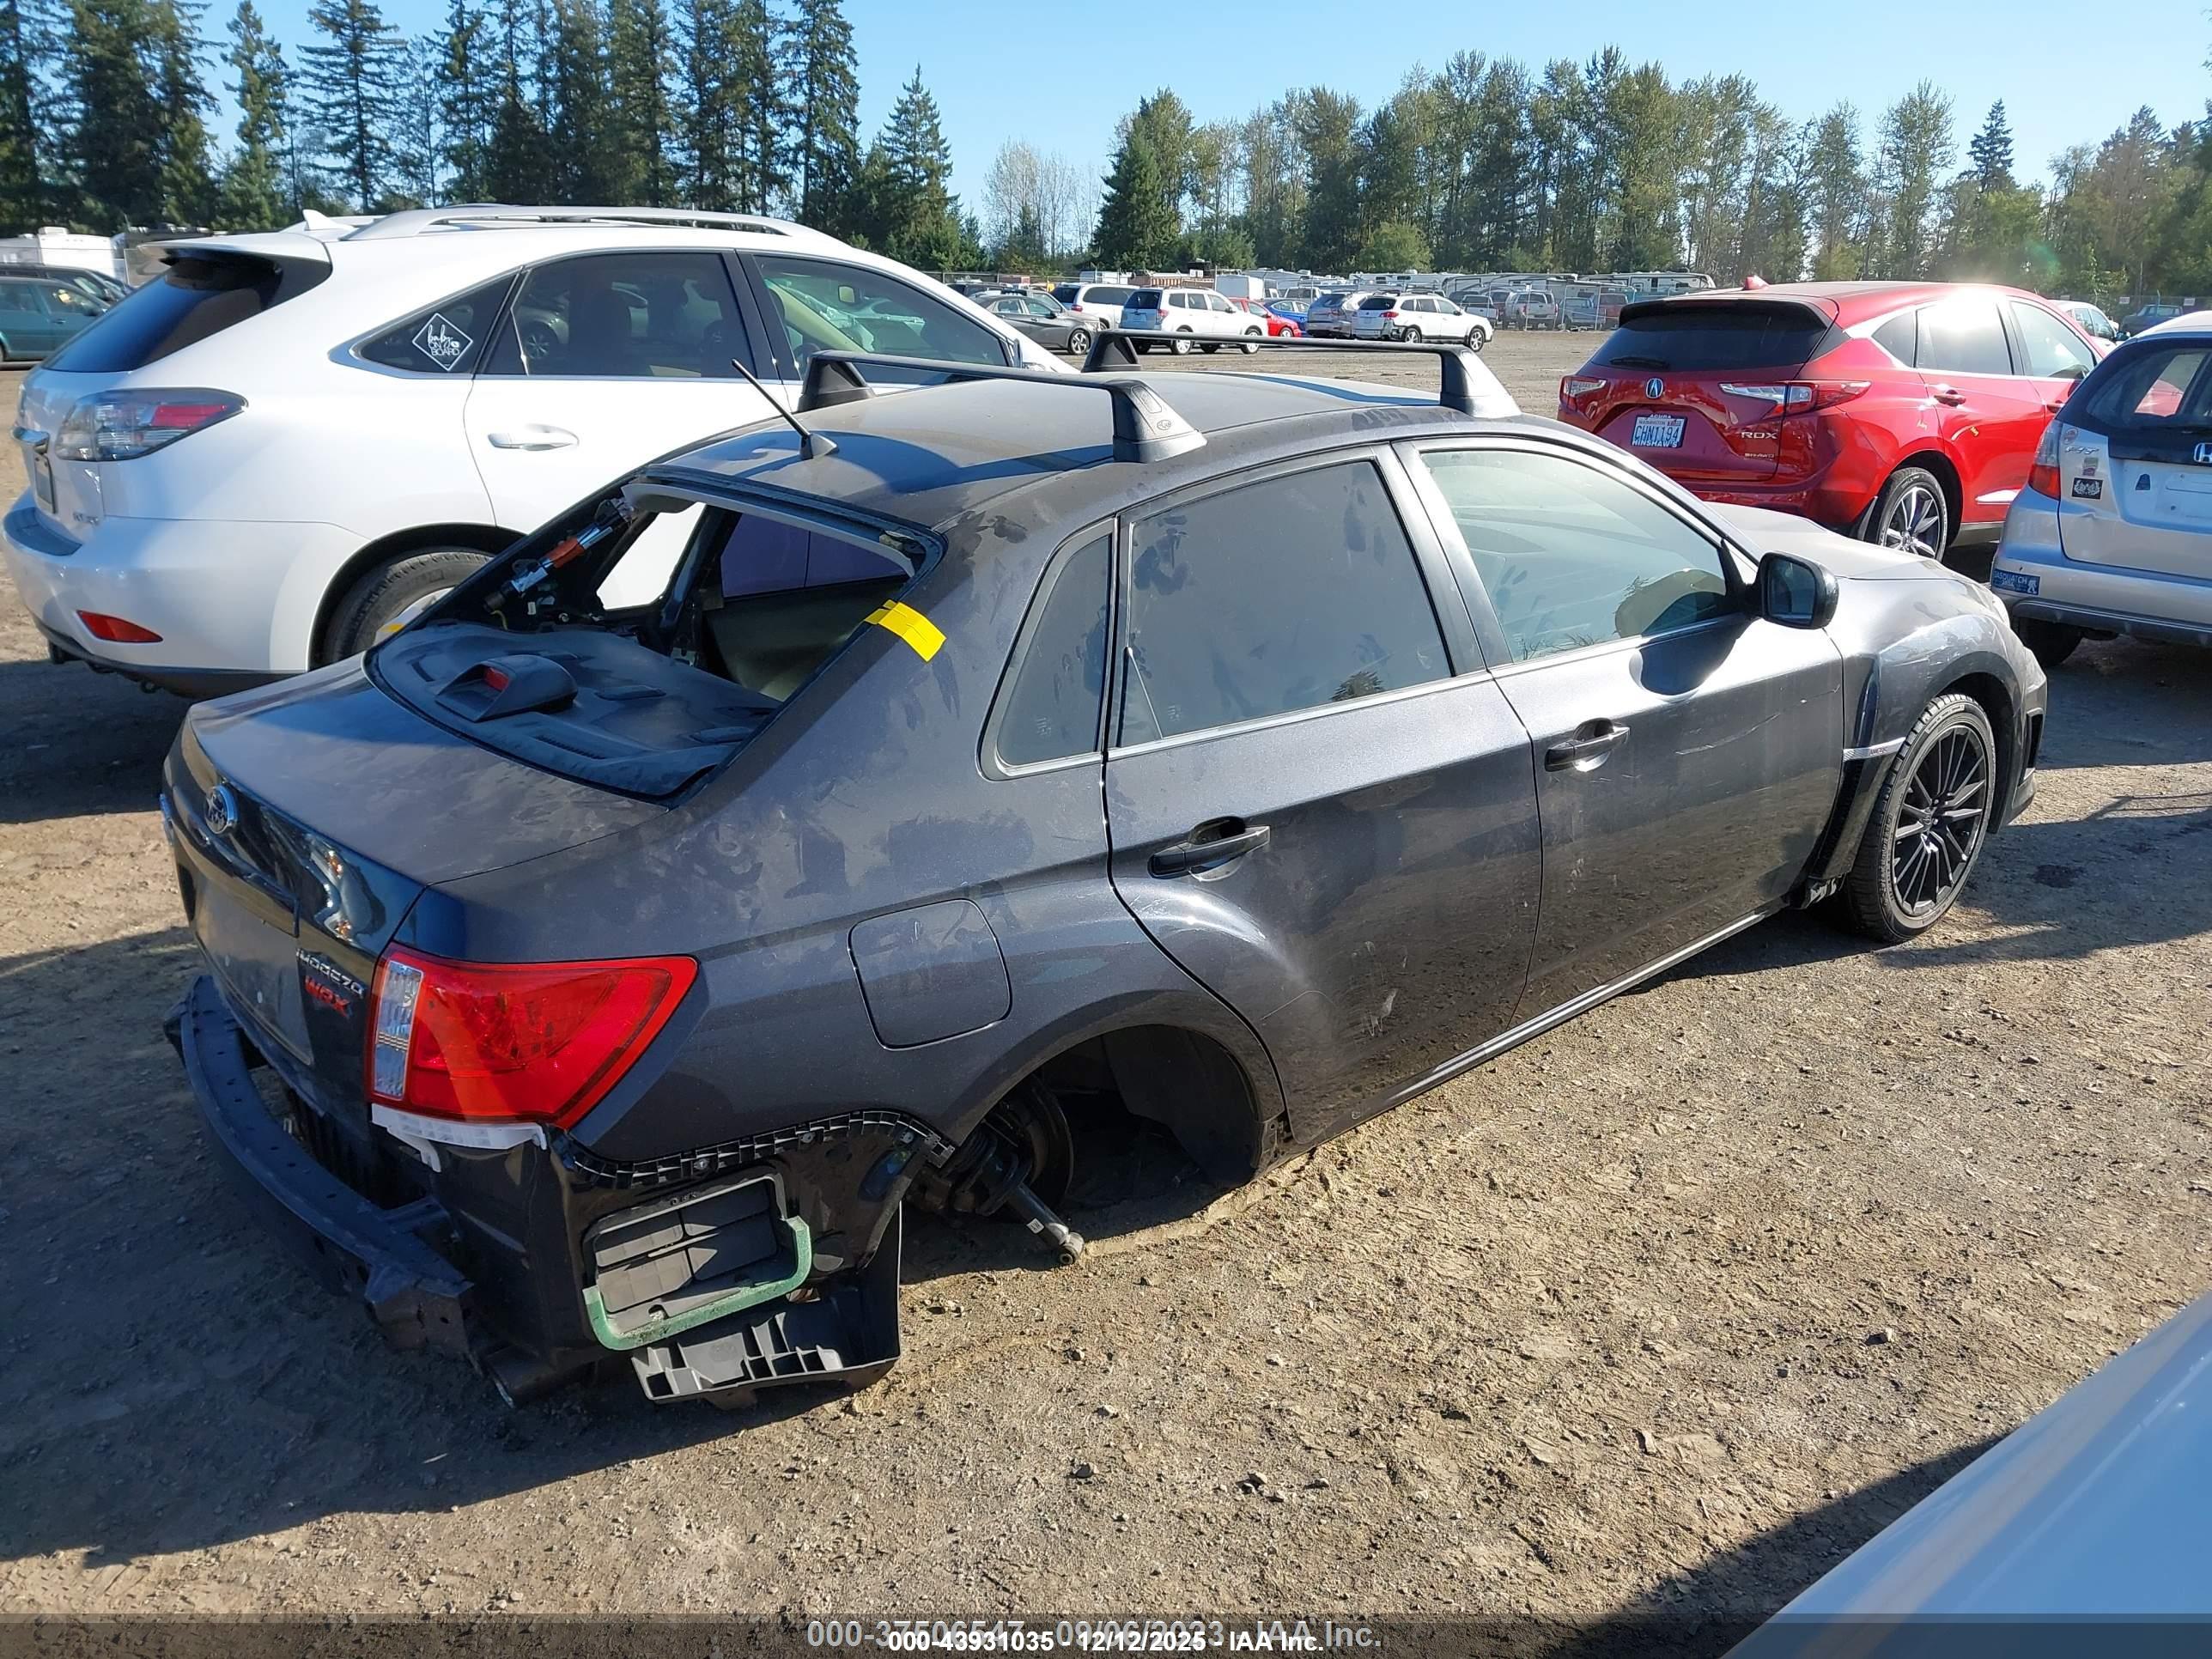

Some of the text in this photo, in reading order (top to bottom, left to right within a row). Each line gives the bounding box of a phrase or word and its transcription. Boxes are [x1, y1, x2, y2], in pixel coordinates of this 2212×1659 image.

[428, 341, 441, 349] ON
[431, 347, 460, 356] BOARD
[1634, 425, 1680, 441] CHN1194
[1741, 431, 1778, 440] RDX
[305, 975, 351, 1018] WRX
